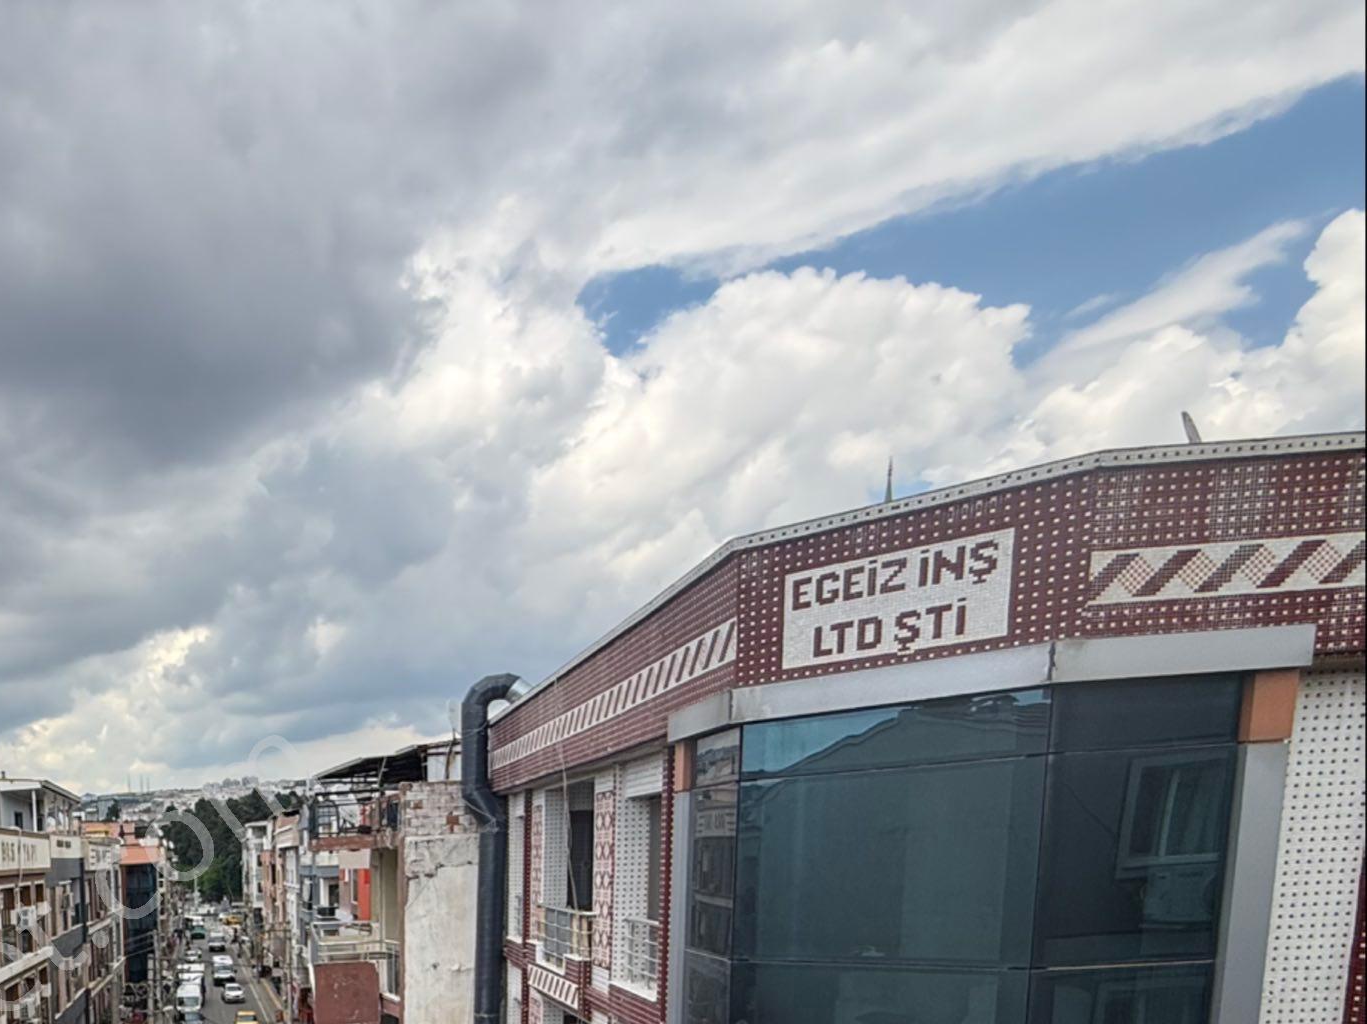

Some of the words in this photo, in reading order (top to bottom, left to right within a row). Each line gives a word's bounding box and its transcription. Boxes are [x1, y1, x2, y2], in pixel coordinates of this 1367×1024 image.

[918, 540, 999, 587] İNŞ
[813, 616, 882, 658] LTD
[894, 597, 967, 651] ŞTİ
